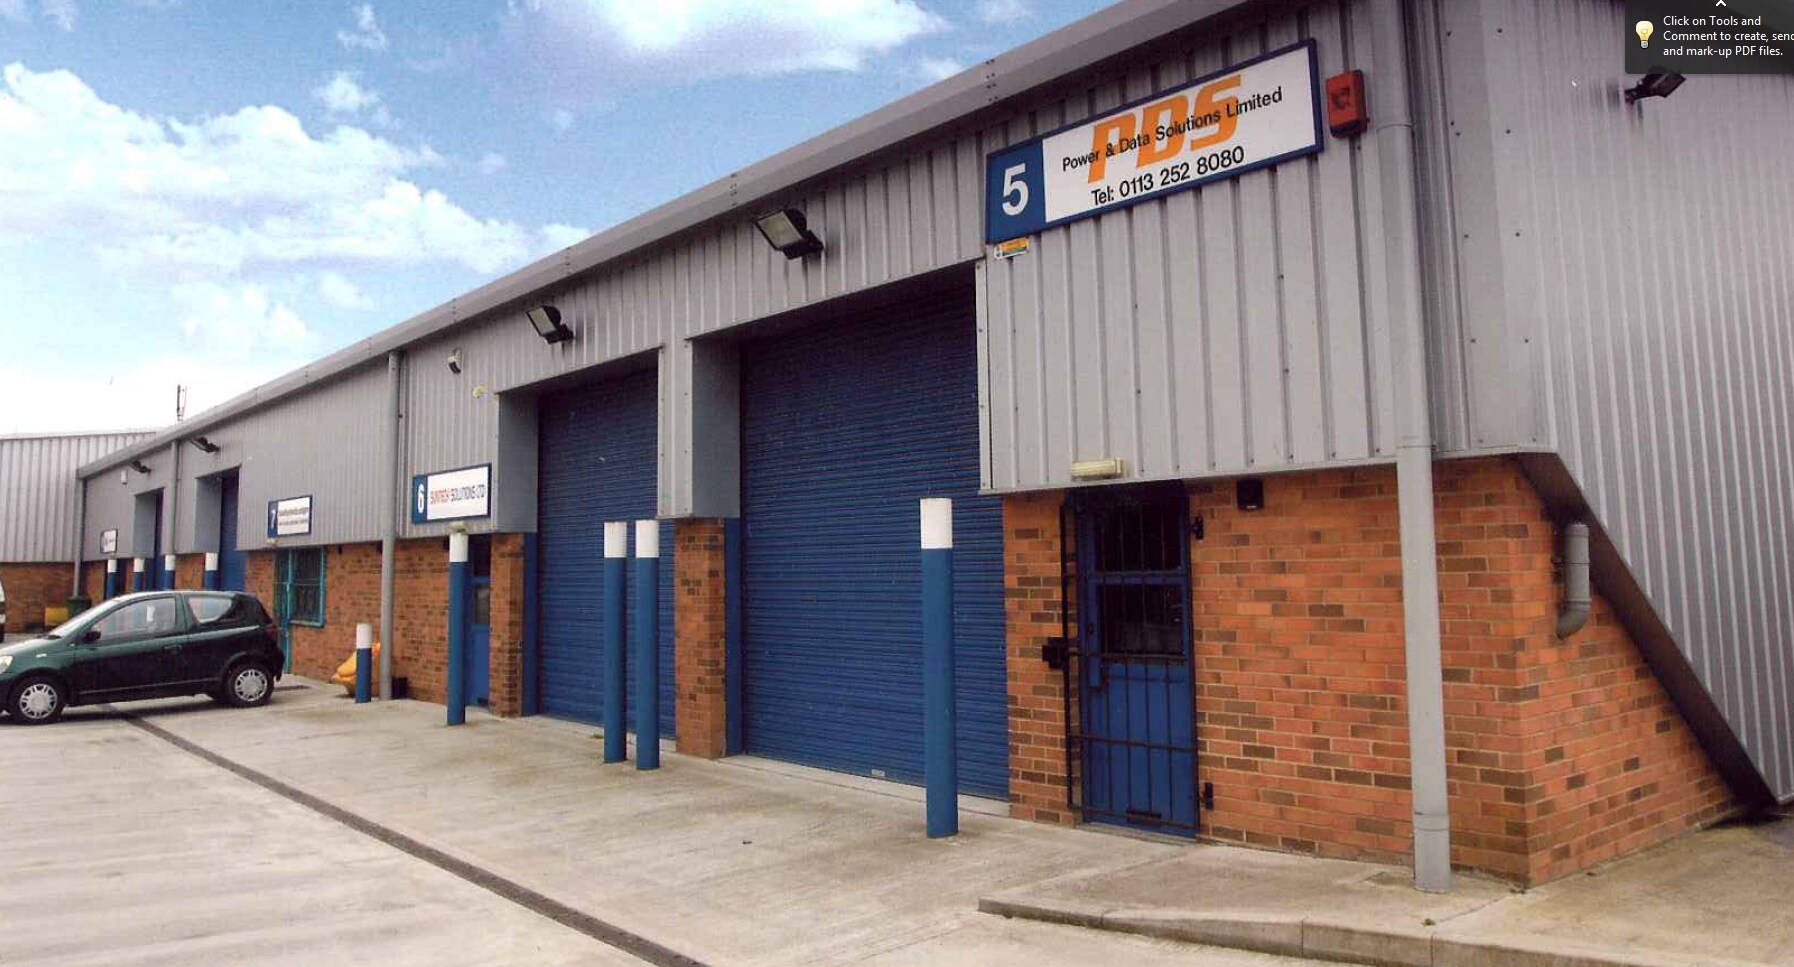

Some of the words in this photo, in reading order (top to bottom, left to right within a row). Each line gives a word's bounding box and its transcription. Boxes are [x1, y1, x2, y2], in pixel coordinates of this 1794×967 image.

[1062, 150, 1101, 171] Power
[1105, 144, 1116, 158] &
[1119, 133, 1151, 155] Data
[1155, 111, 1222, 141] Solutions
[1226, 86, 1283, 118] Limited
[1088, 74, 1242, 184] PDS
[1002, 163, 1030, 215] 5
[1091, 186, 1116, 206] Tel:
[1119, 172, 1155, 198] 0113
[1160, 162, 1190, 187] 252
[1196, 145, 1245, 175] 8080
[271, 508, 277, 529] 7
[417, 483, 425, 514] 6
